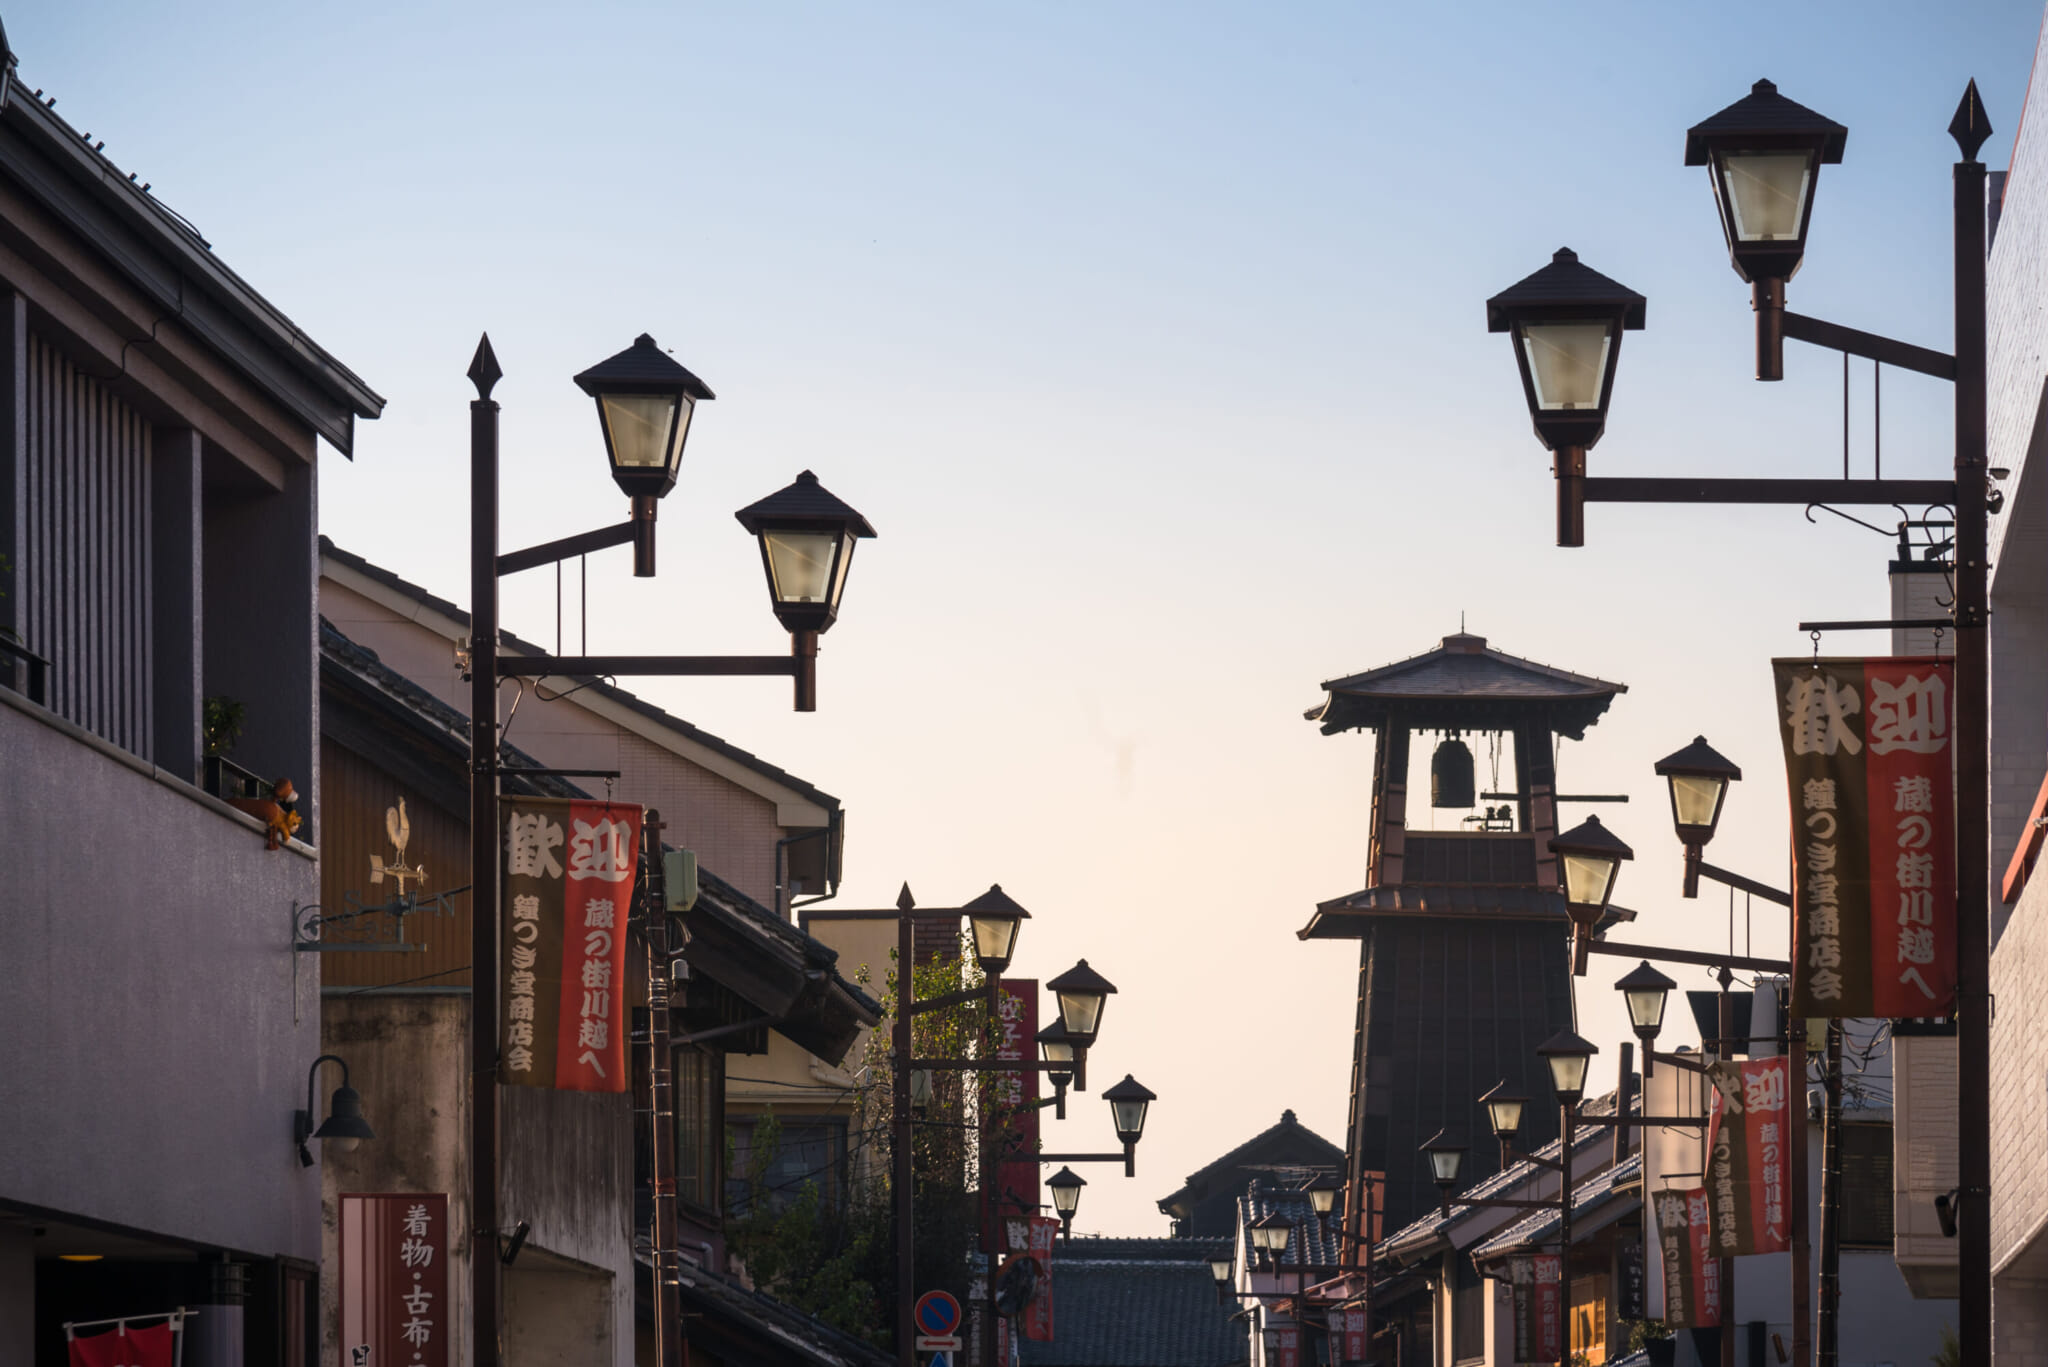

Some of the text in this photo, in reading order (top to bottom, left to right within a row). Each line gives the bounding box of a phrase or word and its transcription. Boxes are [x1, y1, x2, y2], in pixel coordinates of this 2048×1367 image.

[1785, 673, 1948, 757] 歓迎
[504, 810, 632, 884] 歓迎
[1803, 777, 1843, 1001] 鐘つき堂商店会
[1893, 775, 1937, 1000] 蔵の街川越へ
[508, 894, 540, 1073] 鐘つき堂商店会
[577, 897, 615, 1079] 蔵の街川越へ
[1759, 1123, 1784, 1243] 蔵の街川越へ
[400, 1203, 434, 1367] 着物・古布・
